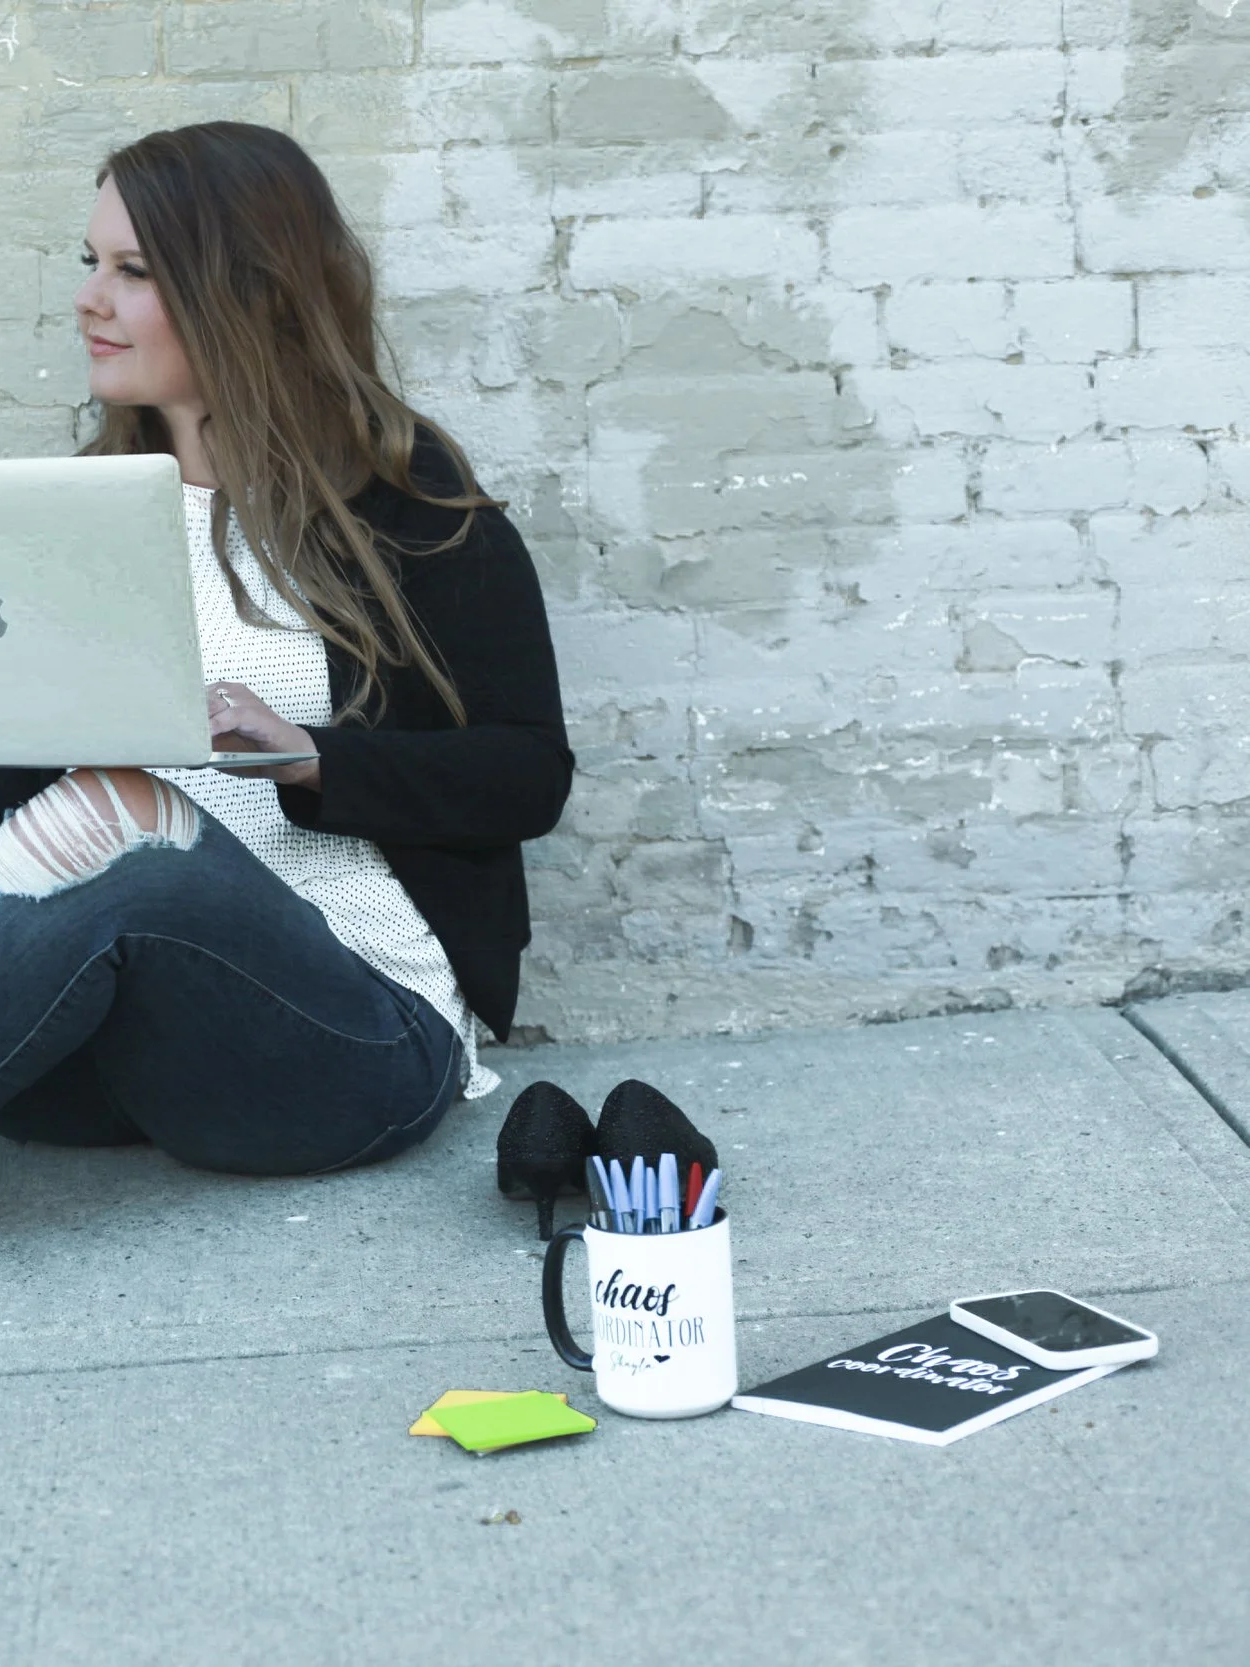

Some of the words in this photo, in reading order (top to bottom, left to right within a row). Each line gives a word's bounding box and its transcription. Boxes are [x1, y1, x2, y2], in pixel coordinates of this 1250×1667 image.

[595, 1268, 680, 1317] chaos
[596, 1313, 706, 1349] ORDINATOR
[826, 1358, 1014, 1395] coordinator
[876, 1342, 1031, 1381] Chaos
